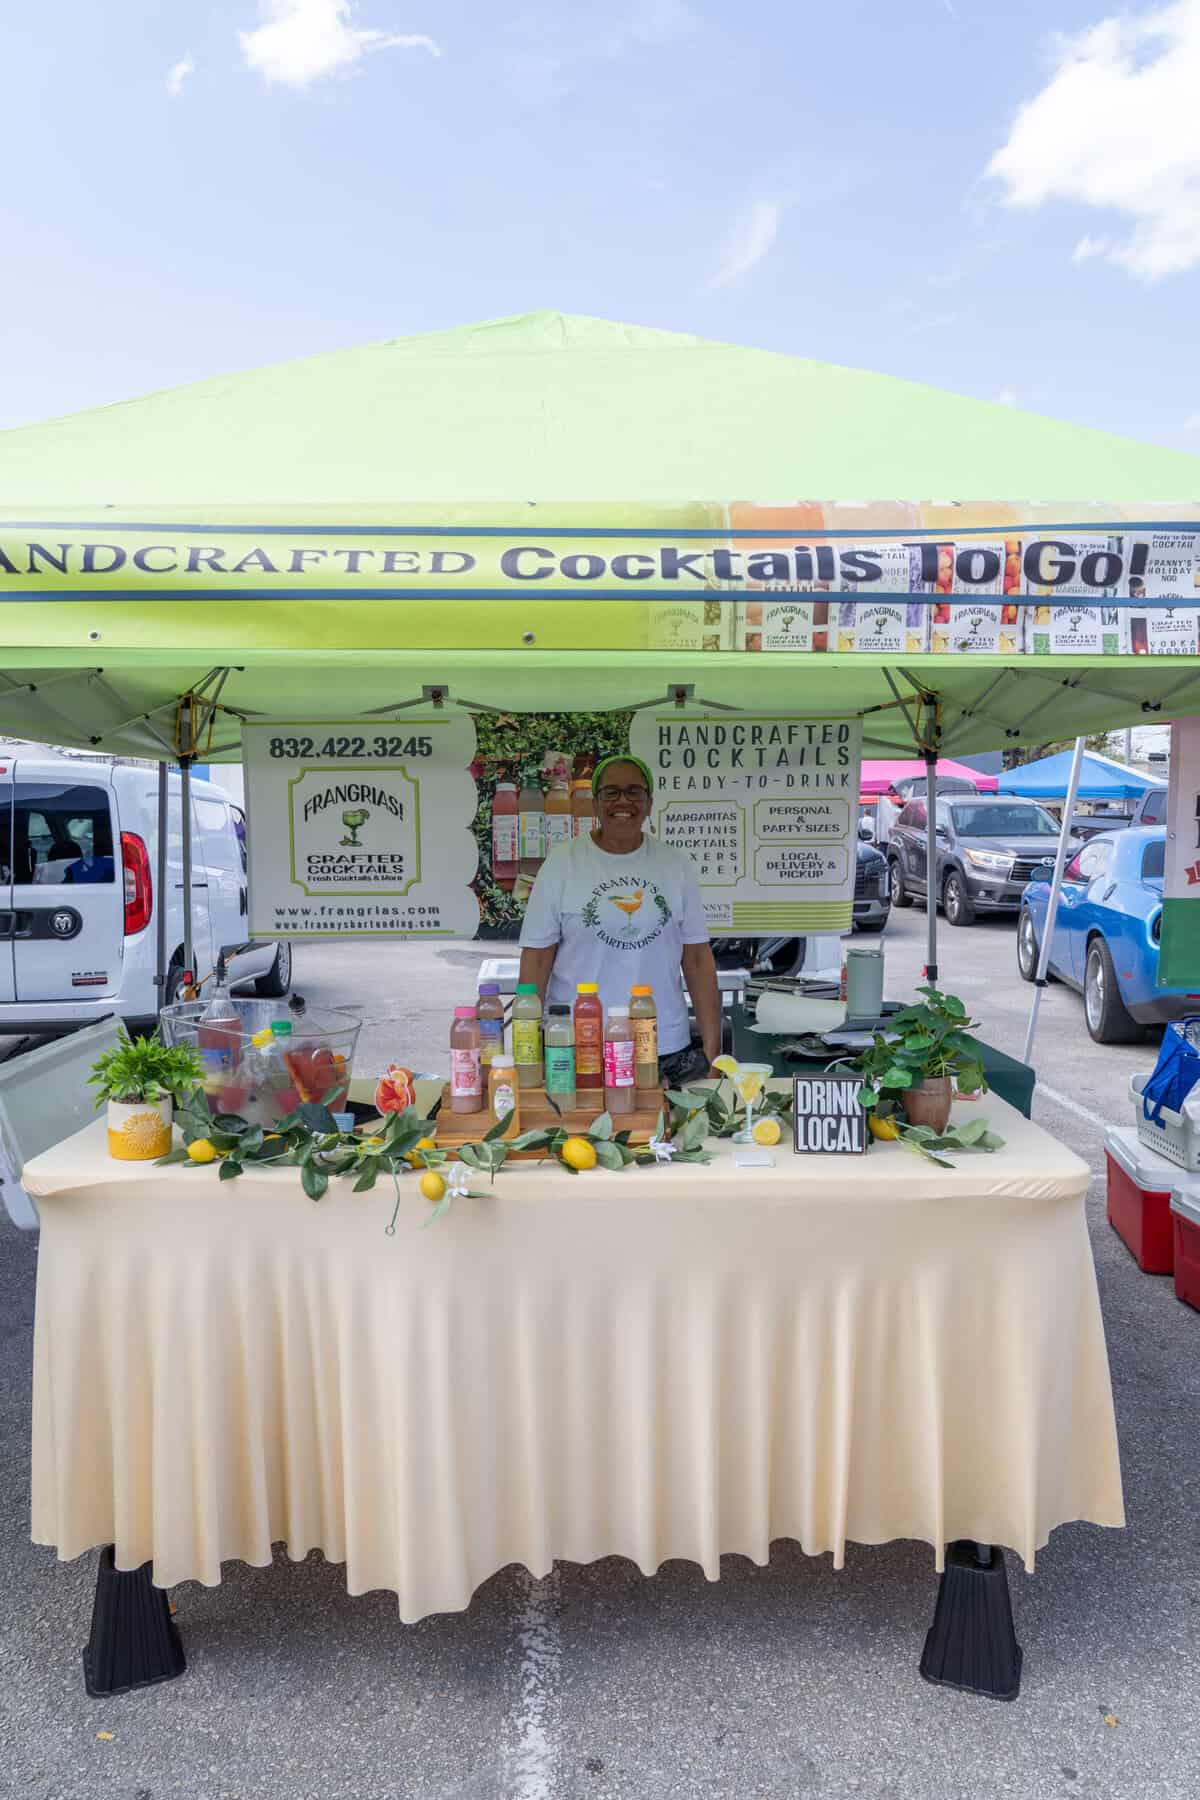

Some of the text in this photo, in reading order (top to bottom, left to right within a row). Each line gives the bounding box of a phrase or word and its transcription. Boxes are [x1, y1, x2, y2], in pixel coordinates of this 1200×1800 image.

[501, 546, 883, 582] Cocktails
[902, 542, 1000, 584] To
[1024, 541, 1149, 588] Go!
[659, 724, 850, 746] HANDCRAFTED
[269, 736, 433, 758] 832.422.3245
[659, 746, 849, 769] COCKTAILS
[659, 774, 849, 790] READY-TO-DRINK
[304, 783, 404, 822] FRANGRIAS!
[769, 806, 832, 815] PERSONAL
[666, 812, 737, 822] MARGARITAS
[796, 815, 806, 824] &
[666, 825, 737, 835] MARTINIS
[763, 824, 840, 833] PARTY SIZES
[307, 854, 404, 864] CRAFTED
[689, 852, 737, 861] XERS
[781, 852, 821, 861] LOCAL
[307, 864, 404, 874] COCKTAILS
[766, 861, 836, 870] DELIVERY &
[779, 870, 824, 879] PICKUP
[592, 876, 659, 898] FRANNY'S
[275, 906, 440, 917] www.frangrias.com
[596, 928, 662, 951] BARTENDING
[797, 1080, 862, 1116] DRINK
[797, 1116, 862, 1152] LOCAL
